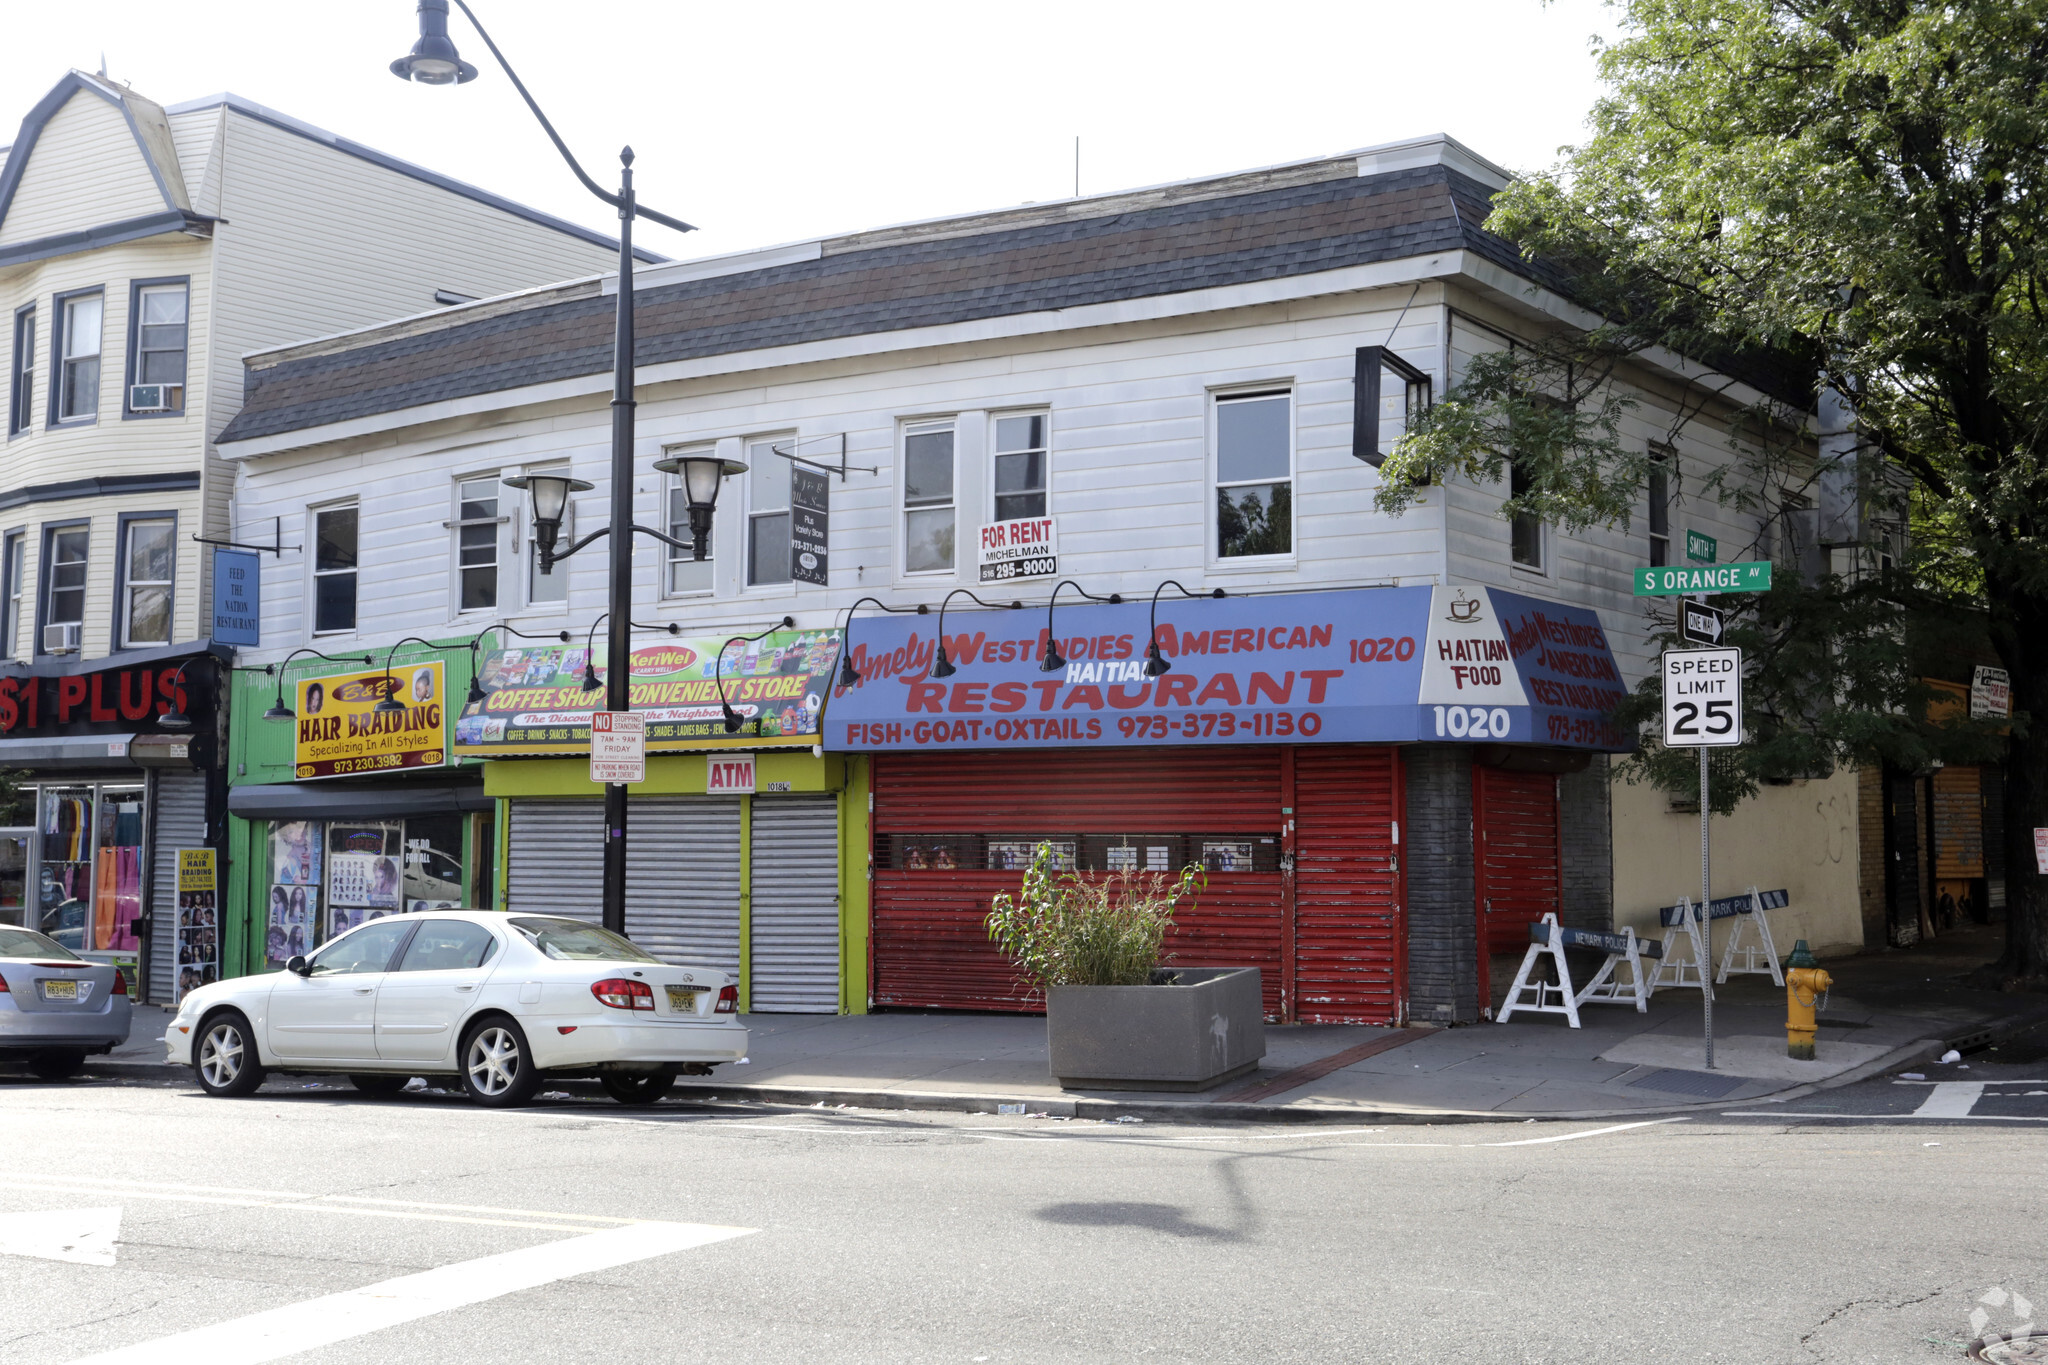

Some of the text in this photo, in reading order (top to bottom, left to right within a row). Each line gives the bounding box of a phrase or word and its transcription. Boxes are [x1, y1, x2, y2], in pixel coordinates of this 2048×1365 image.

[804, 515, 815, 525] Plus
[982, 519, 1052, 549] FOR RENT
[986, 545, 1049, 561] MICHELMAN
[1689, 536, 1709, 558] SMITH
[229, 567, 245, 580] FEED
[996, 558, 1055, 579] 295-9000
[1644, 567, 1760, 590] S ORANGE AV
[231, 584, 243, 596] THE
[225, 600, 248, 613] NATION
[216, 615, 256, 631] RESTAURANT
[1689, 613, 1714, 633] ONE WAY
[834, 623, 1333, 698] Amely WEST INDIES AMERICAN
[1349, 636, 1416, 664] 1020
[1437, 639, 1509, 662] HAITIAN
[1546, 648, 1617, 683] AMERICAN
[1670, 659, 1733, 675] SPEED
[741, 674, 808, 700] STORE
[1450, 665, 1502, 690] FOOD
[1677, 680, 1726, 694] LIMIT
[0, 668, 189, 734] $1 PLUS
[487, 688, 557, 710] COFFEE
[553, 687, 606, 708] SHOP
[906, 669, 1344, 714] RESTAURANT
[1529, 676, 1623, 713] RESTAURANT
[299, 703, 440, 744] HAIR BRAIDING
[524, 714, 542, 723] The
[547, 713, 592, 723] Discoun
[645, 711, 663, 720] the
[595, 715, 641, 730] NO STOPPING
[994, 717, 1102, 743] OXTAILS
[1117, 712, 1322, 739] 973-373-1130
[1433, 705, 1511, 738] 1020
[1672, 700, 1733, 735] 25
[507, 730, 525, 741] COFFEE
[527, 729, 547, 741] DRINKS
[549, 728, 568, 740] SNACKS
[572, 727, 592, 740] TOBACC
[654, 725, 674, 737] SHADES
[677, 724, 695, 736] LADIES
[695, 723, 709, 736] BAGS
[310, 734, 429, 759] Specializing In All Styles
[424, 753, 440, 761] 1018
[298, 768, 314, 776] 1018
[334, 754, 403, 773] 973 230.3982
[710, 763, 753, 788] ATM
[345, 838, 384, 850] OPEN
[408, 838, 430, 849] WE DO
[405, 853, 430, 863] FOR ALL
[1697, 898, 1753, 920] NWARK POLI
[1575, 932, 1628, 950] NEWARK POLICE
